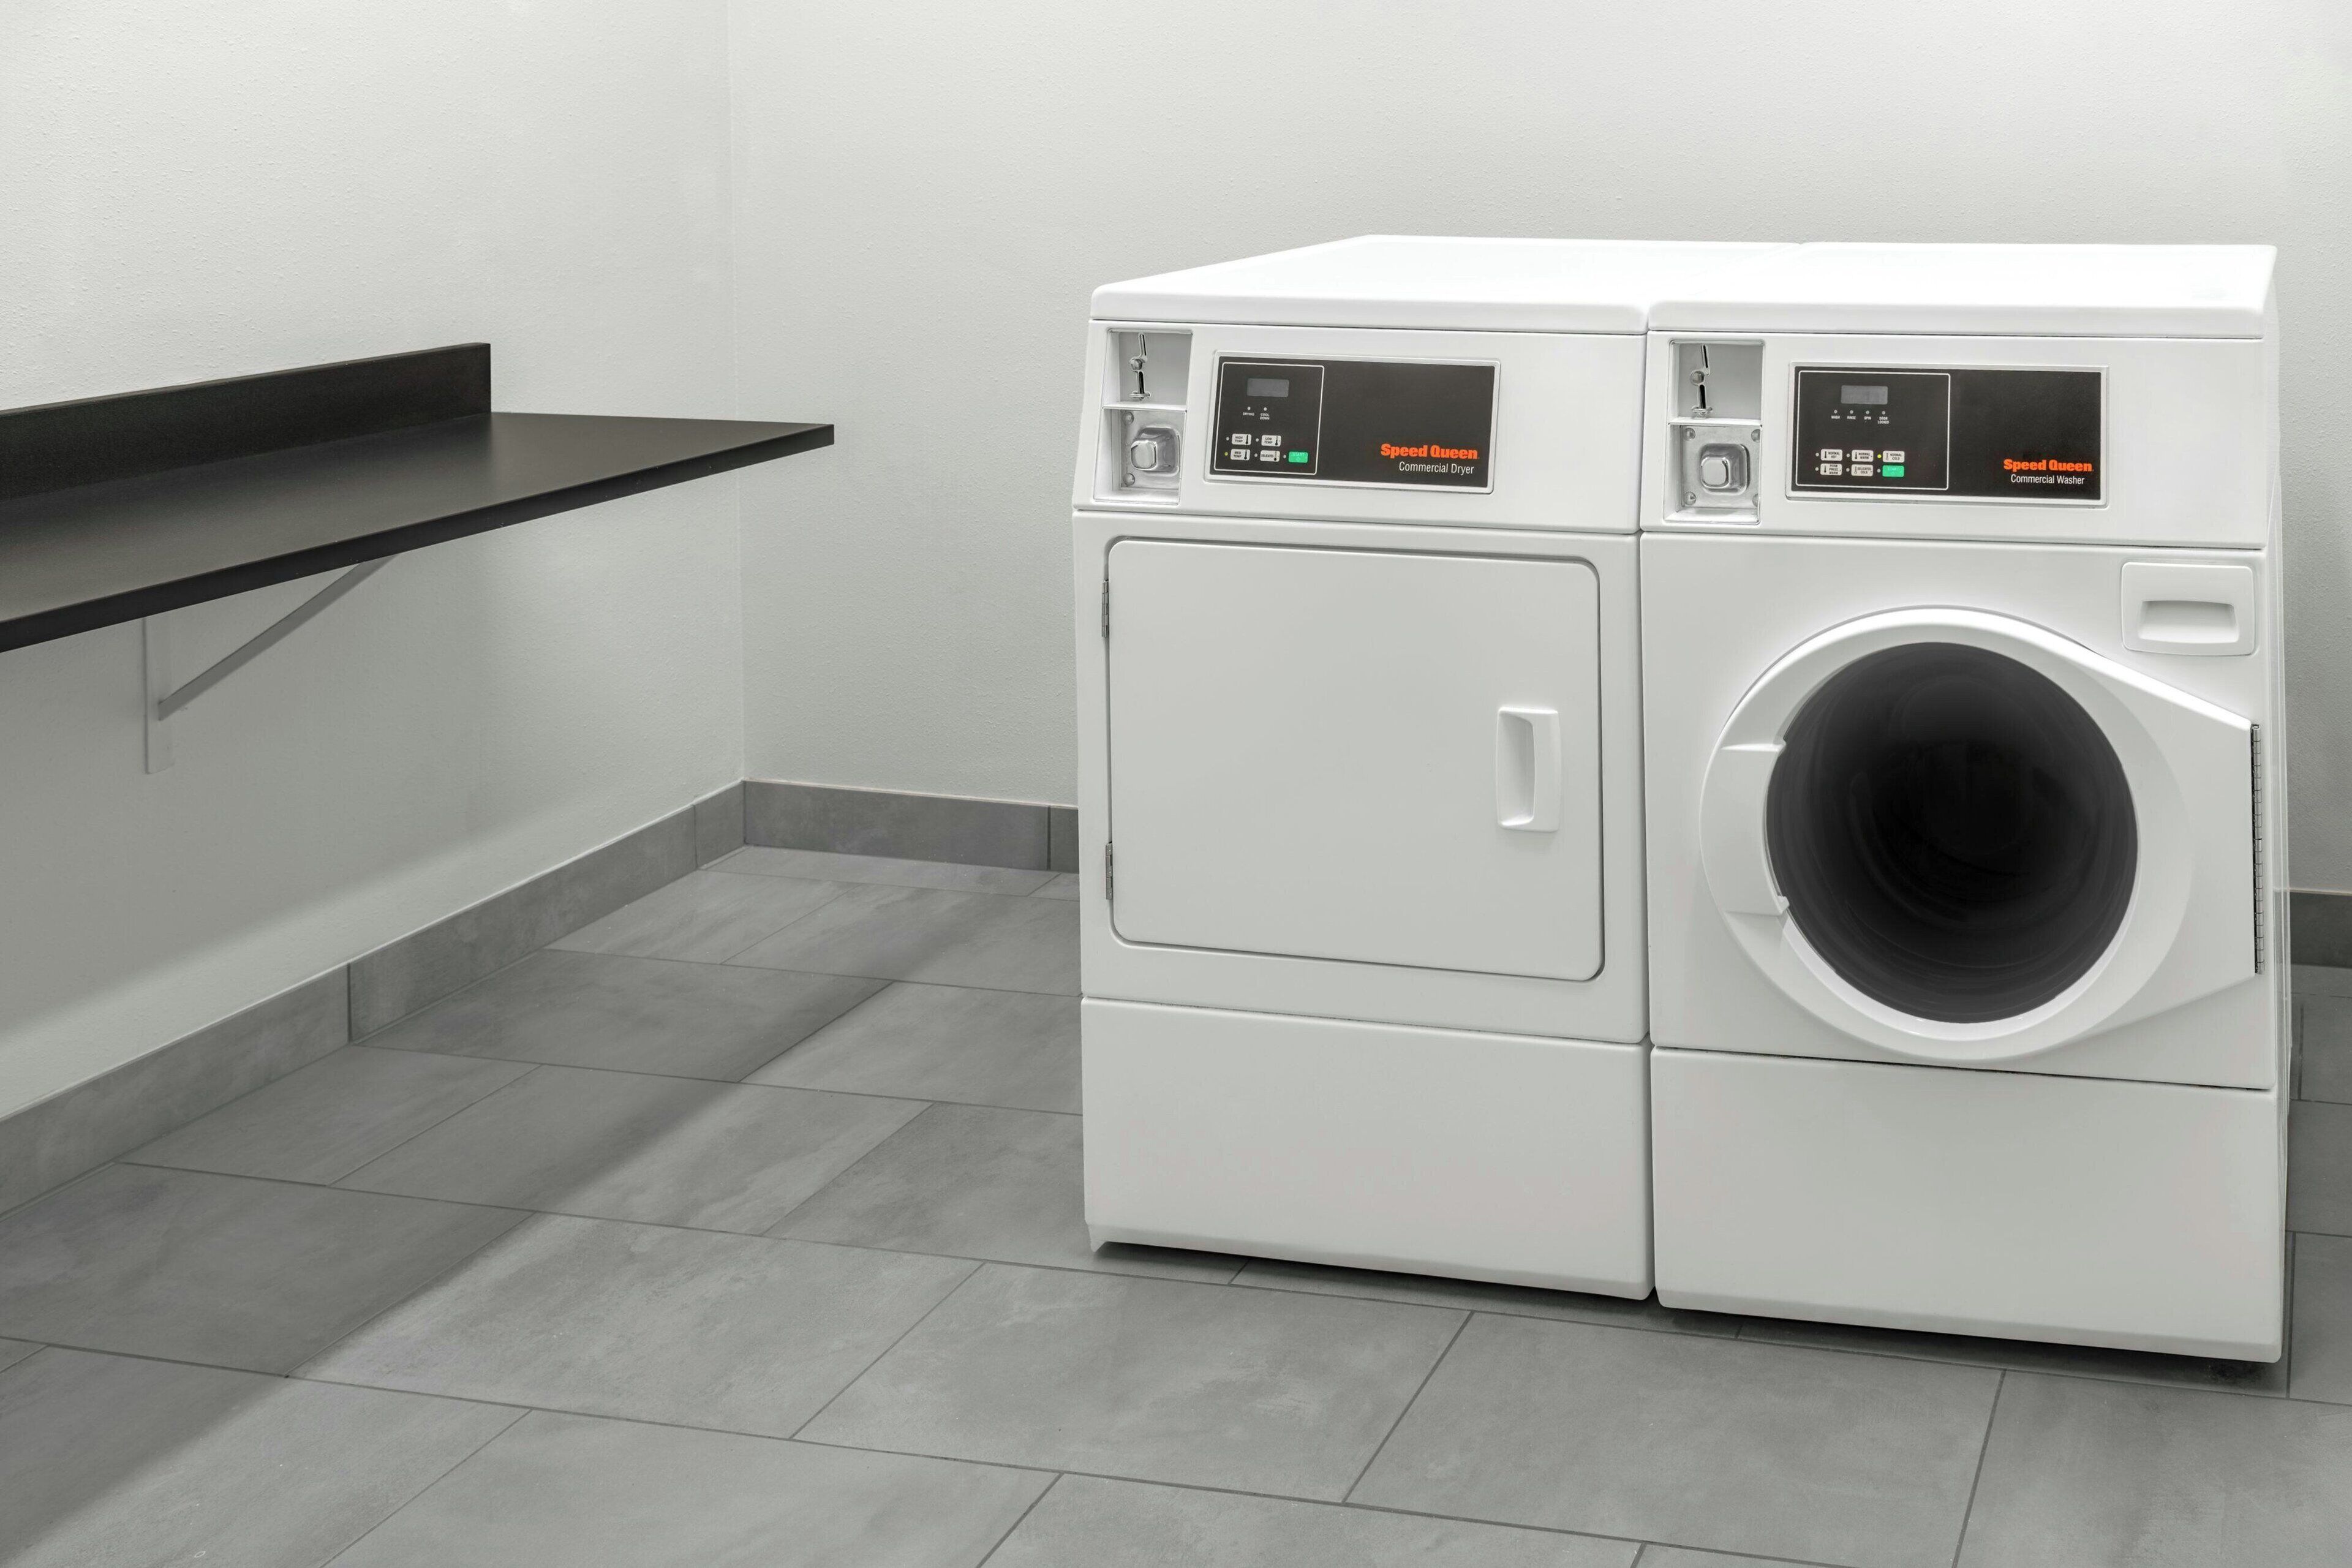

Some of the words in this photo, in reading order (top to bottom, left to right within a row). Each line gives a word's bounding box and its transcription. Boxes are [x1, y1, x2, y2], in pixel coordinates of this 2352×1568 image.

[1381, 443, 1428, 459] Speed
[1430, 445, 1479, 459] Queen
[1399, 461, 1449, 473] Commercial
[1451, 464, 1474, 476] Dryer
[2003, 459, 2047, 472] Speed
[2048, 459, 2092, 472] Queen
[2010, 473, 2055, 484] Commercial
[2056, 475, 2085, 485] Washer
